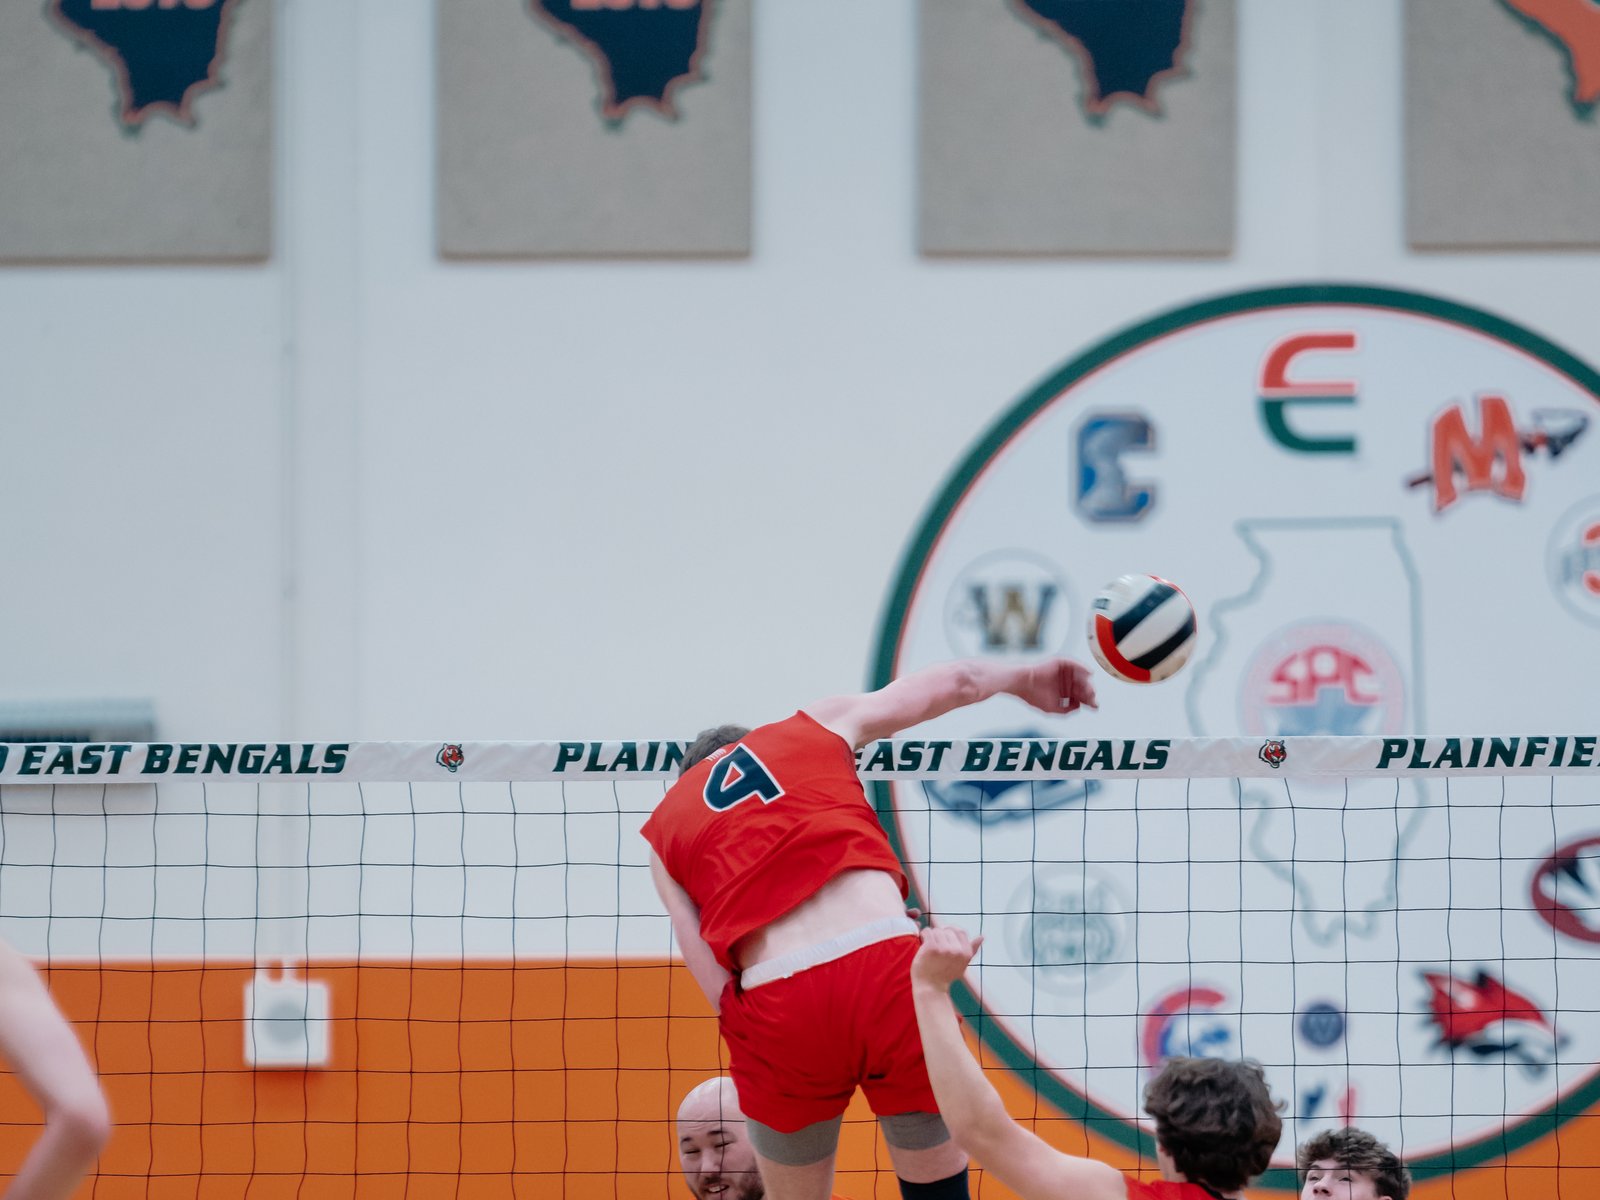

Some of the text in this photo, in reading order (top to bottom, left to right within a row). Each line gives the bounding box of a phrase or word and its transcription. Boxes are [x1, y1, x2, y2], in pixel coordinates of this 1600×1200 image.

[16, 745, 132, 775] EAST
[140, 743, 350, 774] BENGALS
[552, 739, 1171, 772] PLAIN AST BENGALS
[1375, 736, 1600, 769] PLAINFIE
